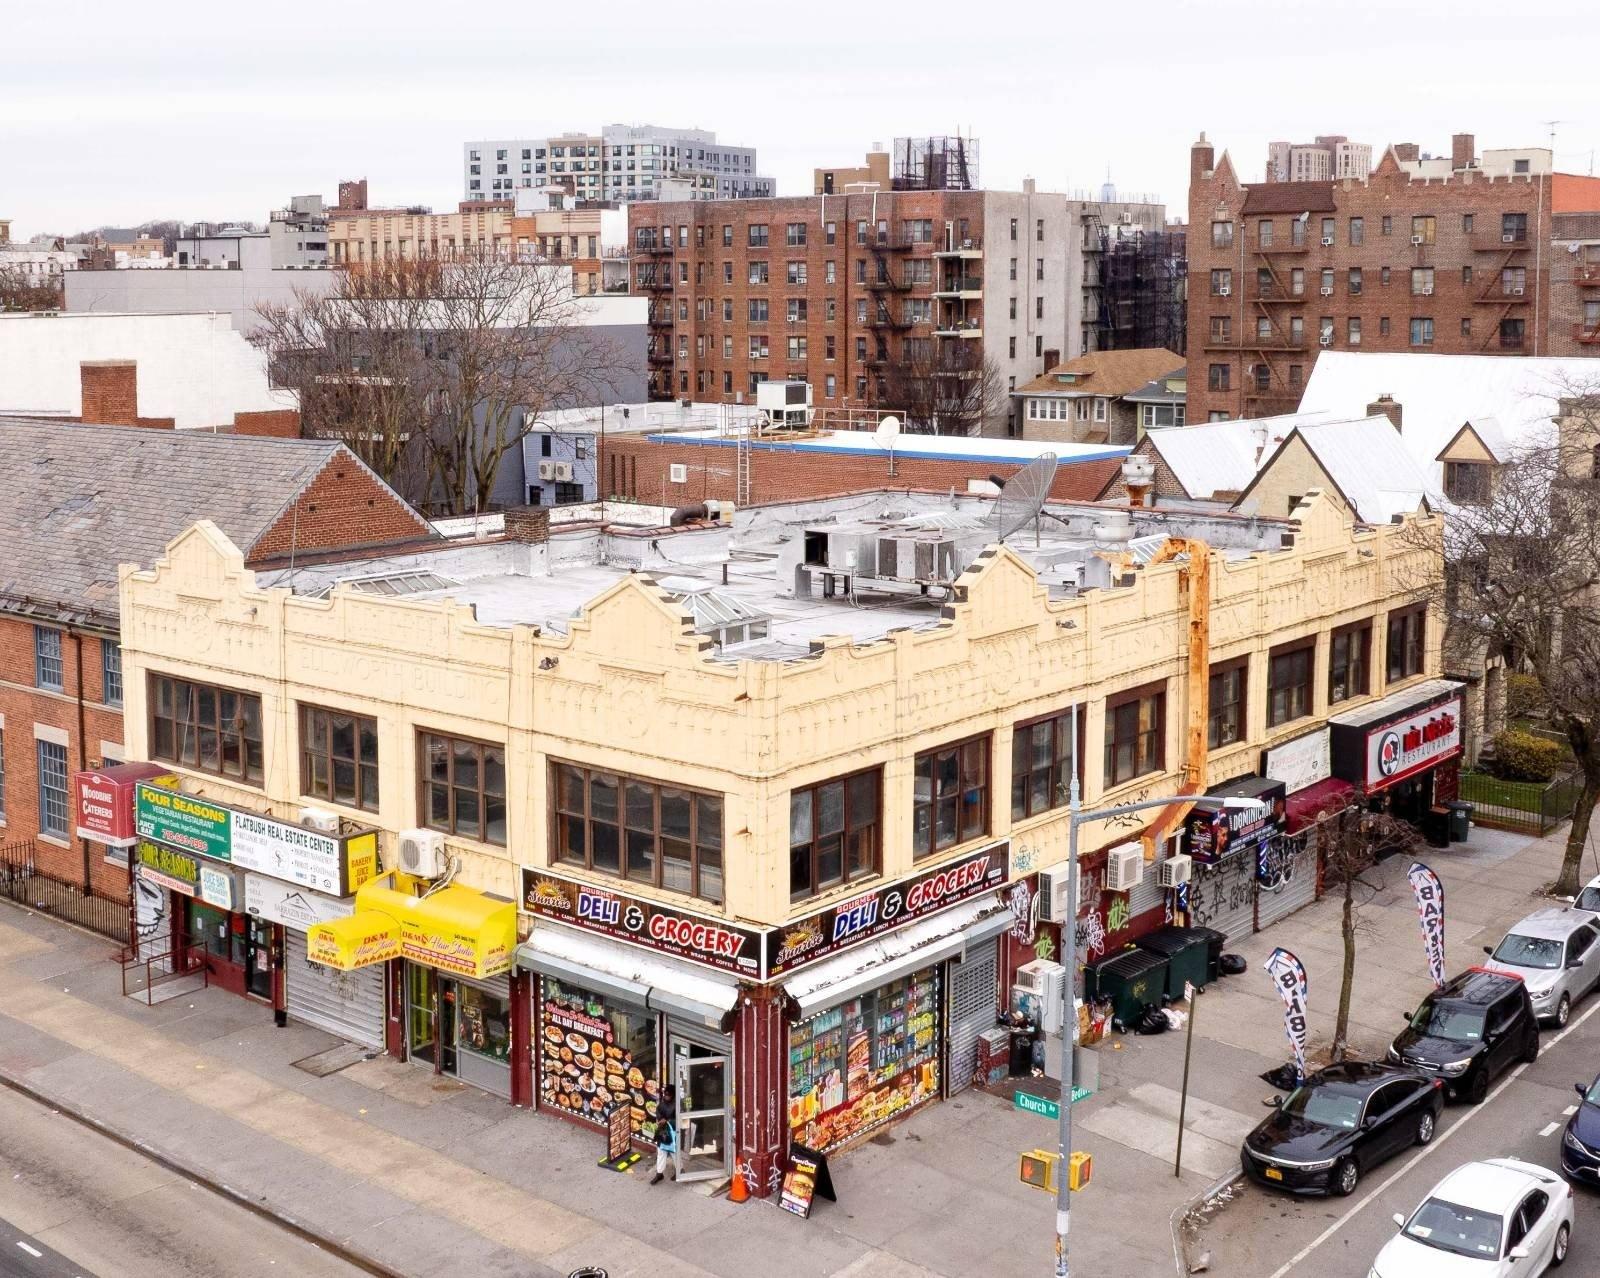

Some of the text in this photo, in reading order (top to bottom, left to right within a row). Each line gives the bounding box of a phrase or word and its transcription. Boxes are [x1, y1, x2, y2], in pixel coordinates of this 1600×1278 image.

[413, 667, 500, 704] BUILDING
[1402, 735, 1451, 765] RESTAURANT
[82, 800, 113, 819] CATERERS
[141, 788, 171, 808] FOUR
[173, 797, 226, 823] SEASONS
[152, 805, 182, 820] VEGETARIAN
[183, 813, 214, 829] RESTAURANT
[1233, 799, 1271, 831] DOMINICAN
[235, 815, 334, 855] FLATBUSH REAL ESTATE CENTER
[160, 849, 197, 882] SEASONS
[352, 855, 372, 868] BAKERY
[528, 891, 571, 910] Sunrise
[580, 886, 615, 899] GOURMET
[832, 897, 879, 942] DELI
[882, 891, 902, 920] &
[906, 855, 990, 911] GROCERY
[836, 892, 876, 914] GOURMET
[577, 893, 746, 958] DELI & GROCERY
[791, 957, 806, 966] SODA
[814, 944, 831, 956] CANDY
[840, 930, 866, 946] BREAKFAST
[873, 922, 889, 933] LUNCH
[896, 912, 914, 923] DINNER
[922, 902, 939, 913] SALADS
[946, 893, 961, 903] WRAPS
[968, 884, 984, 894] COFFEE
[990, 876, 1002, 885] MORE
[363, 931, 389, 945] D&M
[402, 931, 421, 942] D&M
[428, 935, 449, 950] Hair
[448, 940, 475, 957] Studio
[561, 913, 576, 922] CANDY
[583, 920, 608, 931] BREAKFAST
[614, 929, 630, 938] LUNCH
[638, 935, 656, 946] DINNER
[664, 943, 682, 953] SALADS
[690, 951, 707, 961] WRAPS
[715, 958, 733, 968] COFFEE
[743, 966, 757, 975] MORE
[775, 933, 824, 965] Sunrise
[552, 1014, 562, 1025] ALL
[562, 1016, 573, 1028] DAY
[573, 1021, 605, 1039] BREAKFAST
[1020, 1094, 1047, 1114] Church
